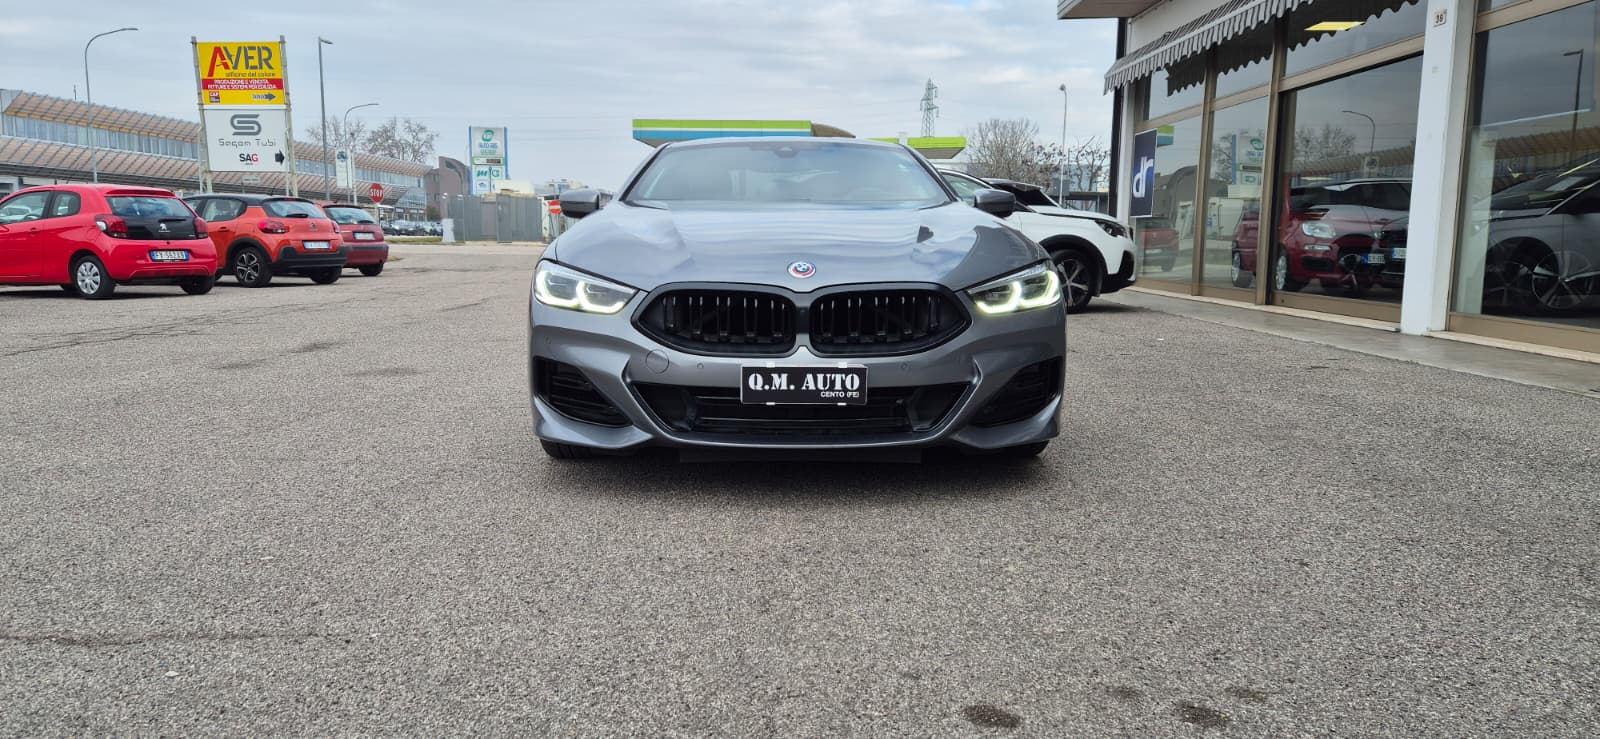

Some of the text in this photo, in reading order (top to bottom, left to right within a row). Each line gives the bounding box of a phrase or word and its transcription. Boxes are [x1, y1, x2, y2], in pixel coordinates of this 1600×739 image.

[207, 46, 274, 77] AVER
[239, 153, 259, 162] SAG
[370, 188, 383, 197] STOP
[748, 373, 860, 391] Q.M. AUTO
